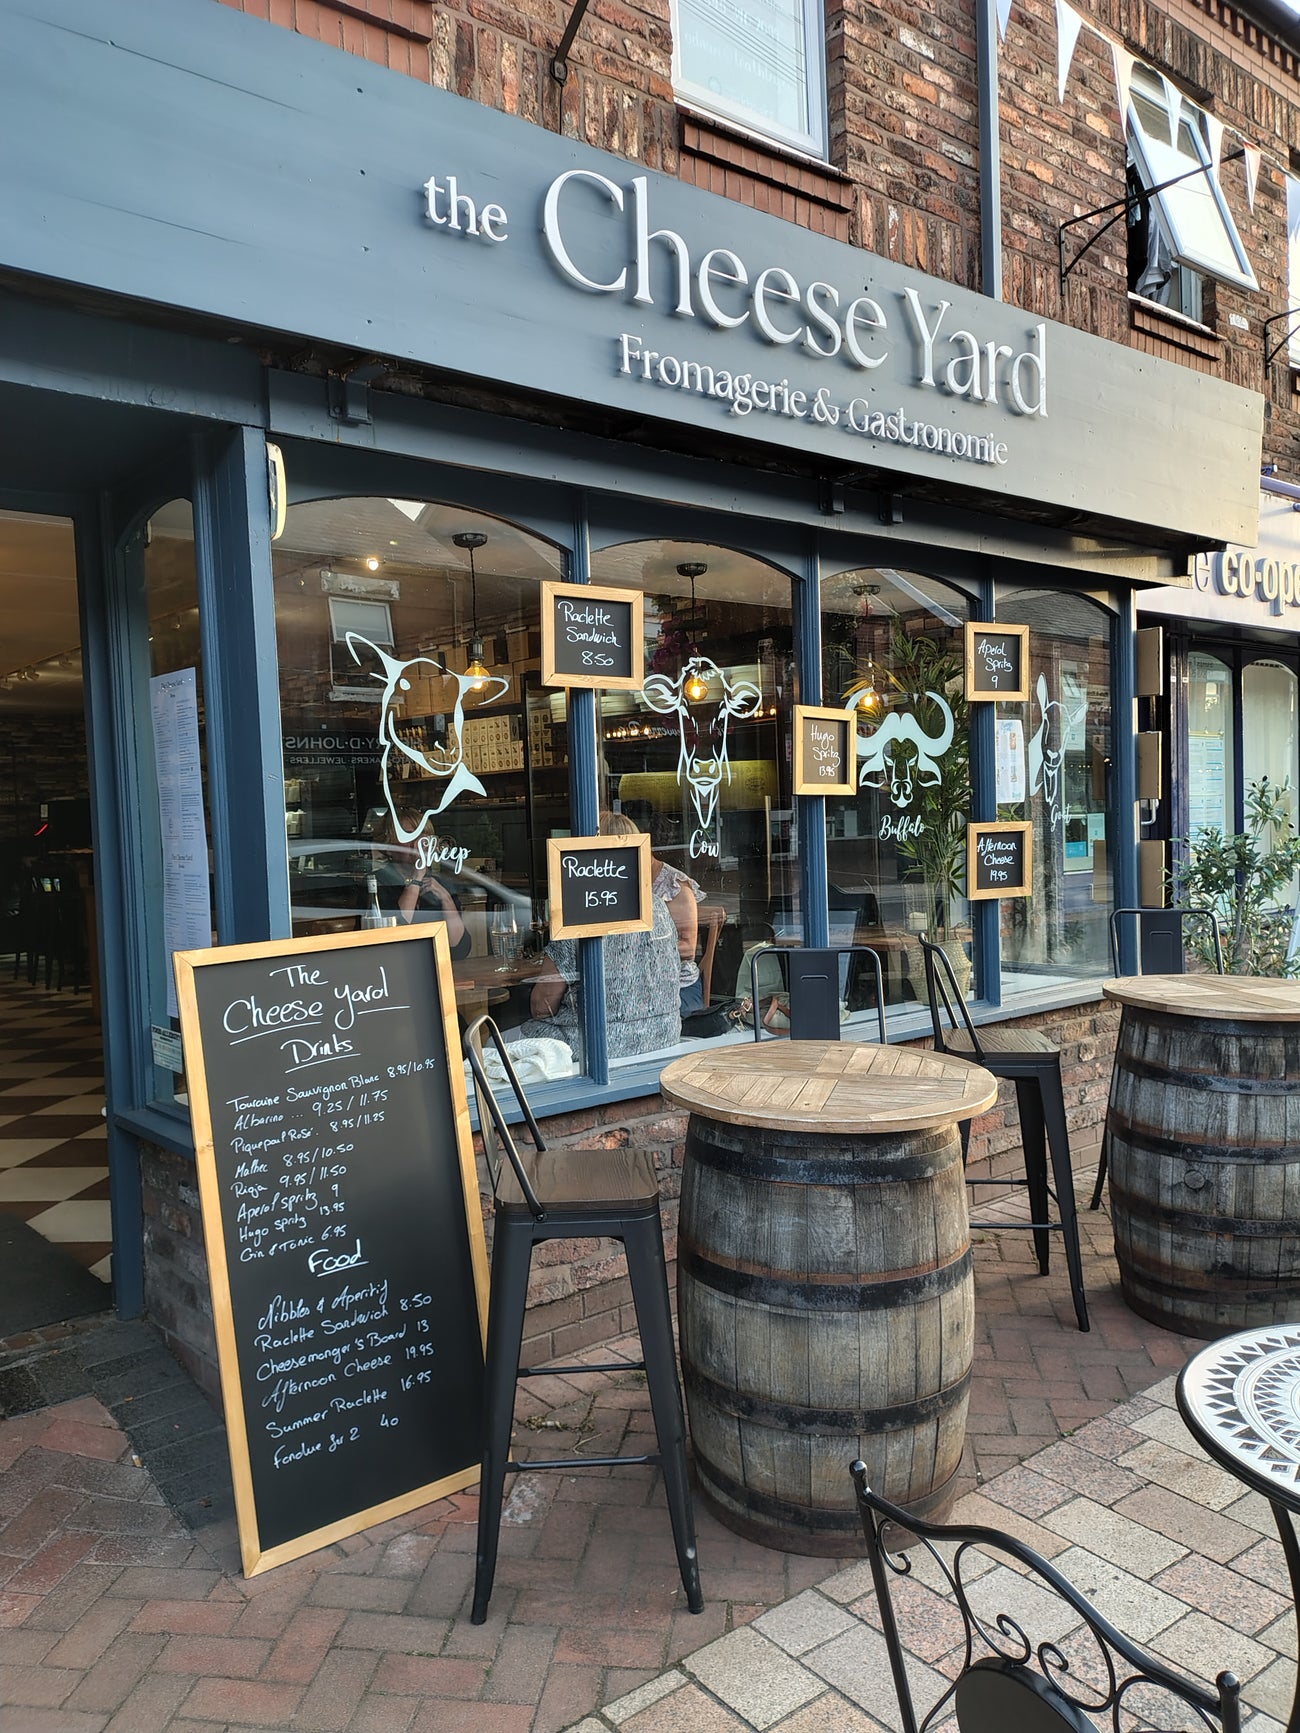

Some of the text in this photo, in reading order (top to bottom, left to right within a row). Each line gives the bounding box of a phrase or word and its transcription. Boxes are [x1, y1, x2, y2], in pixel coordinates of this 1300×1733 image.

[424, 169, 1048, 418] the Cheese Yard
[619, 333, 1008, 465] Fromagerie & Gastronomie
[558, 601, 615, 627] Raclette
[566, 626, 622, 647] Sandwich
[978, 638, 1007, 656] Aperol
[581, 650, 614, 667] 8.50
[985, 657, 1013, 673] Spritz
[991, 675, 999, 689] 9
[810, 723, 835, 748] Hugo
[812, 746, 840, 768] Spritz
[878, 814, 933, 842] Buffalo
[415, 836, 471, 875] Sheep
[689, 829, 720, 859] Cow
[977, 837, 1017, 857] Afternoon
[562, 855, 629, 880] Raclette
[983, 853, 1015, 867] Cheese
[990, 869, 1008, 882] 19.95
[585, 891, 618, 908] 15.95
[269, 964, 329, 987] The
[223, 995, 324, 1034] Cheese
[280, 1033, 353, 1064] Drinks
[226, 1095, 280, 1112] Touraine
[286, 1081, 348, 1102] Sauvignon
[350, 1073, 380, 1089] Blanc
[234, 1114, 284, 1131] Albarino
[230, 1132, 286, 1156] Piquepoul
[235, 1159, 269, 1179] Malbec
[230, 1182, 268, 1199] Rioja
[237, 1192, 280, 1224] Aperol
[331, 1183, 339, 1198] 9
[239, 1227, 270, 1247] Hugo
[319, 1202, 345, 1216] 13.95
[240, 1247, 265, 1262] Gin
[279, 1235, 315, 1253] Tonic
[321, 1225, 348, 1241] 6.95
[307, 1238, 362, 1274] Food
[258, 1294, 311, 1331] Nibbles
[331, 1279, 388, 1311] Aperitif
[254, 1293, 432, 1352] Raclette Sandwich 8.50
[366, 1323, 408, 1348] Board
[417, 1319, 430, 1333] 13
[262, 1343, 434, 1413] Afternoon Cheese 19.95
[265, 1370, 432, 1438] Summer Raclette 16.95
[274, 1442, 323, 1470] Fondue
[349, 1427, 361, 1442] 2
[380, 1413, 399, 1428] 40
